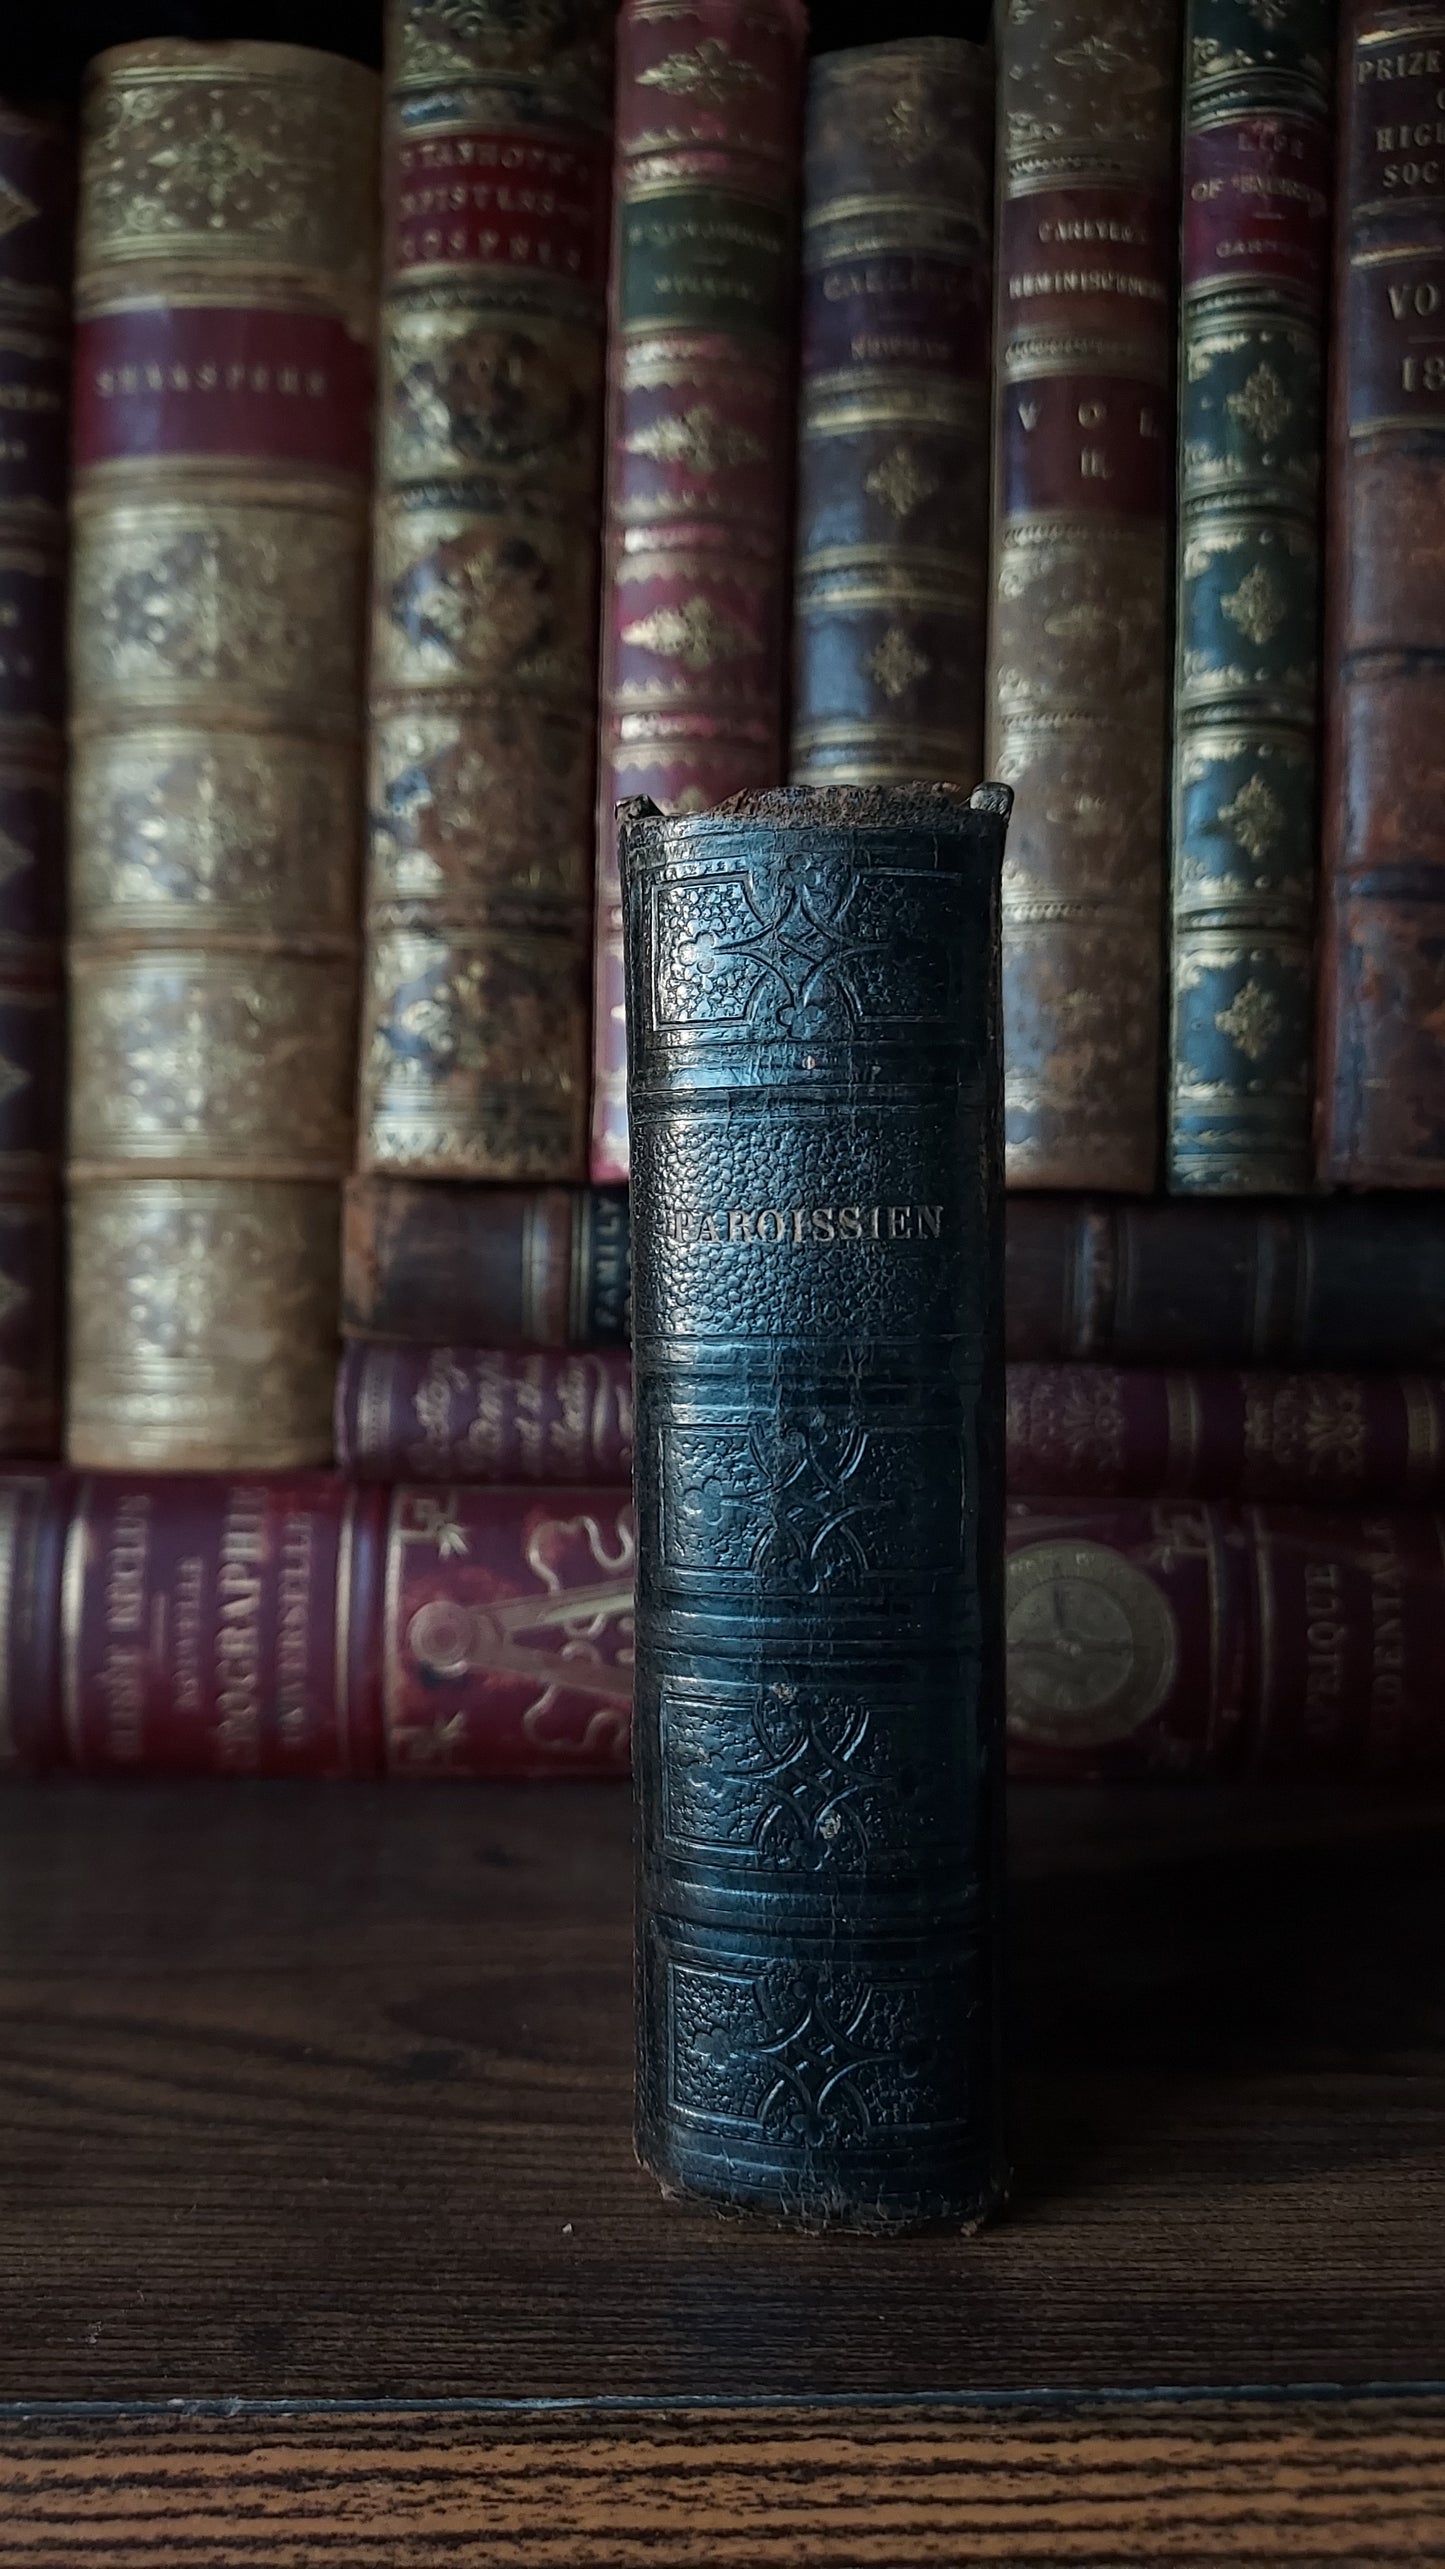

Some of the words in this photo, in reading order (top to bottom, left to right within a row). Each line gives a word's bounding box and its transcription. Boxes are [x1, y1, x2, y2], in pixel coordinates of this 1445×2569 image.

[1382, 160, 1445, 188] SOC
[1038, 218, 1148, 243] CARLYLE
[1009, 271, 1169, 303] REMINISCENC
[672, 1204, 945, 1244] PAROISSIEN
[208, 1486, 270, 1769] OGRAPHI
[1304, 1563, 1349, 1743] RIQUE
